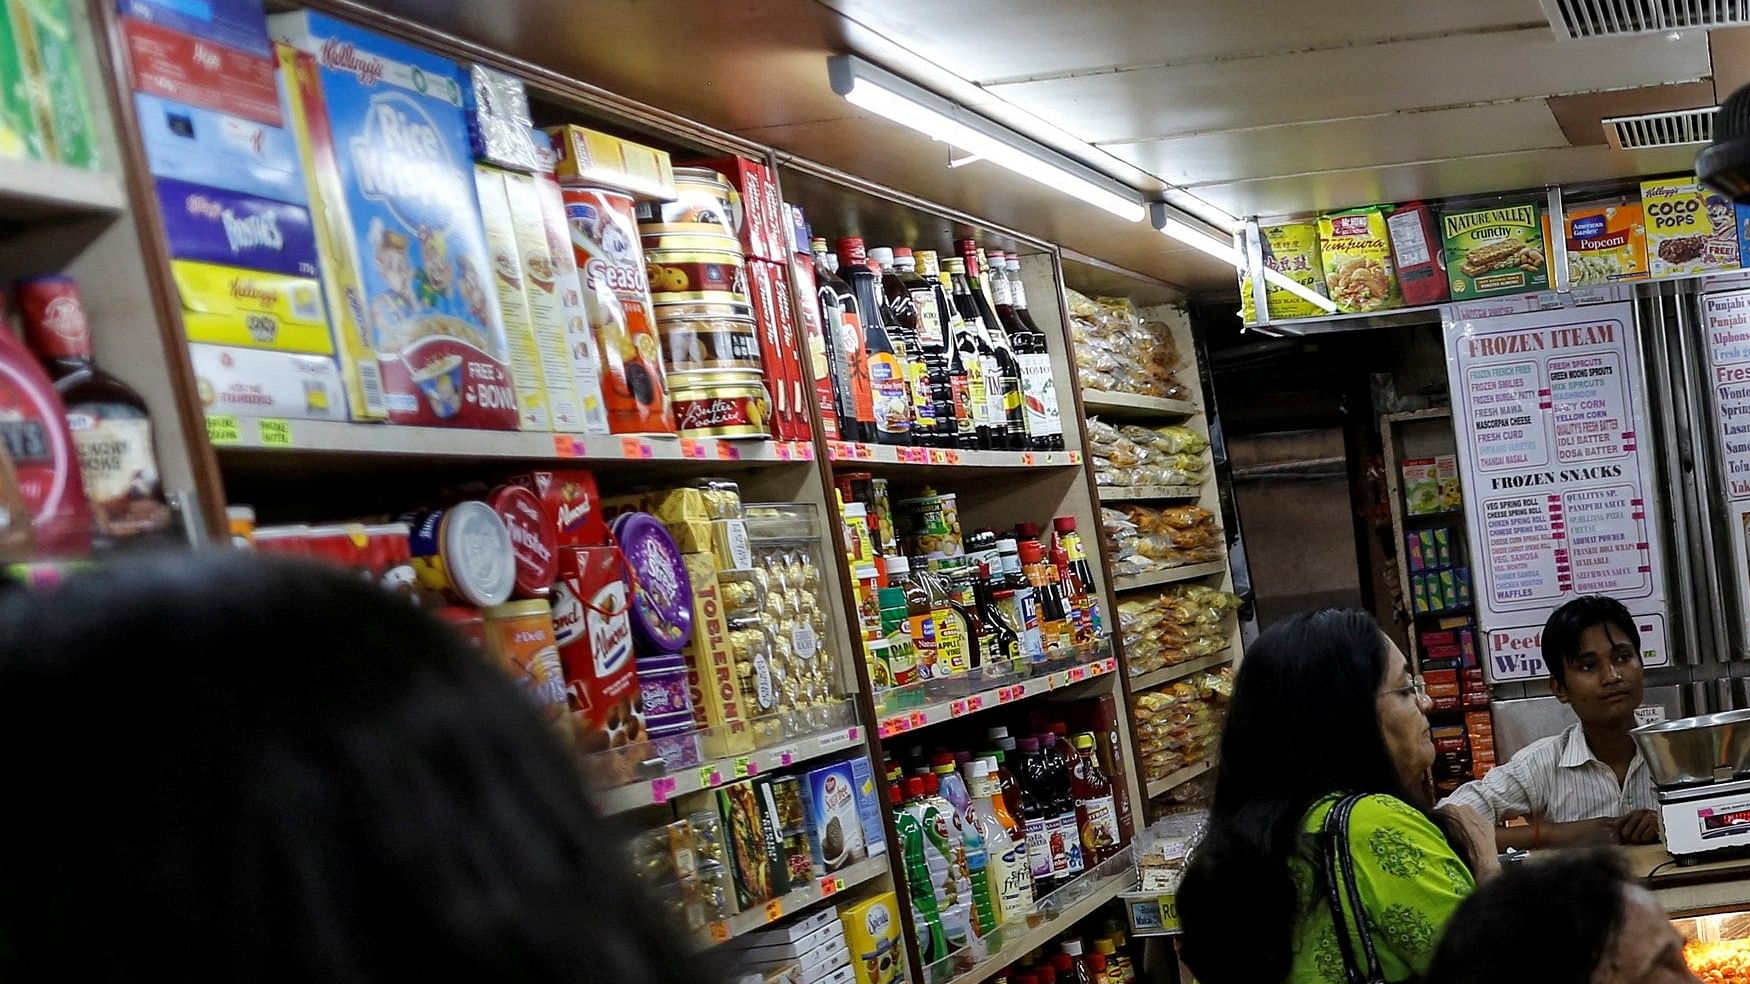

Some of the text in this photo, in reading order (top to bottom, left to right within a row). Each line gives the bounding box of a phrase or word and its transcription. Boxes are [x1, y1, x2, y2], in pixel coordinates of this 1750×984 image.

[377, 98, 441, 155] Rice
[1645, 187, 1679, 198] Kellogg's
[1648, 200, 1699, 217] COCO
[1447, 207, 1533, 236] NATURE VALLEY
[1573, 222, 1604, 230] American
[1655, 214, 1695, 228] POPS
[1581, 236, 1624, 250] Popcorn
[1709, 245, 1733, 255] FREE!
[1708, 298, 1745, 311] Punjabi
[1710, 314, 1747, 328] Punjabi
[1468, 325, 1615, 357] FROZEN ITEAM
[469, 363, 495, 381] FREE
[1471, 381, 1497, 392] FROZEN
[1474, 405, 1523, 418] FRESH MAWA
[1580, 400, 1605, 410] CORN
[1510, 416, 1531, 427] CHEESE
[1556, 410, 1607, 422] YELLOW CORN
[1478, 432, 1501, 442] FRESH
[1577, 433, 1610, 445] BATTER
[1560, 445, 1618, 460] DOSA BATTER
[1491, 465, 1621, 490] FROZEN SNACKS
[1486, 497, 1538, 510] VEG SPRING ROLL
[1487, 506, 1542, 519] CHEESE SPRING ROLL
[1497, 589, 1532, 598] WAFFLES
[701, 586, 745, 735] TOBLERONE
